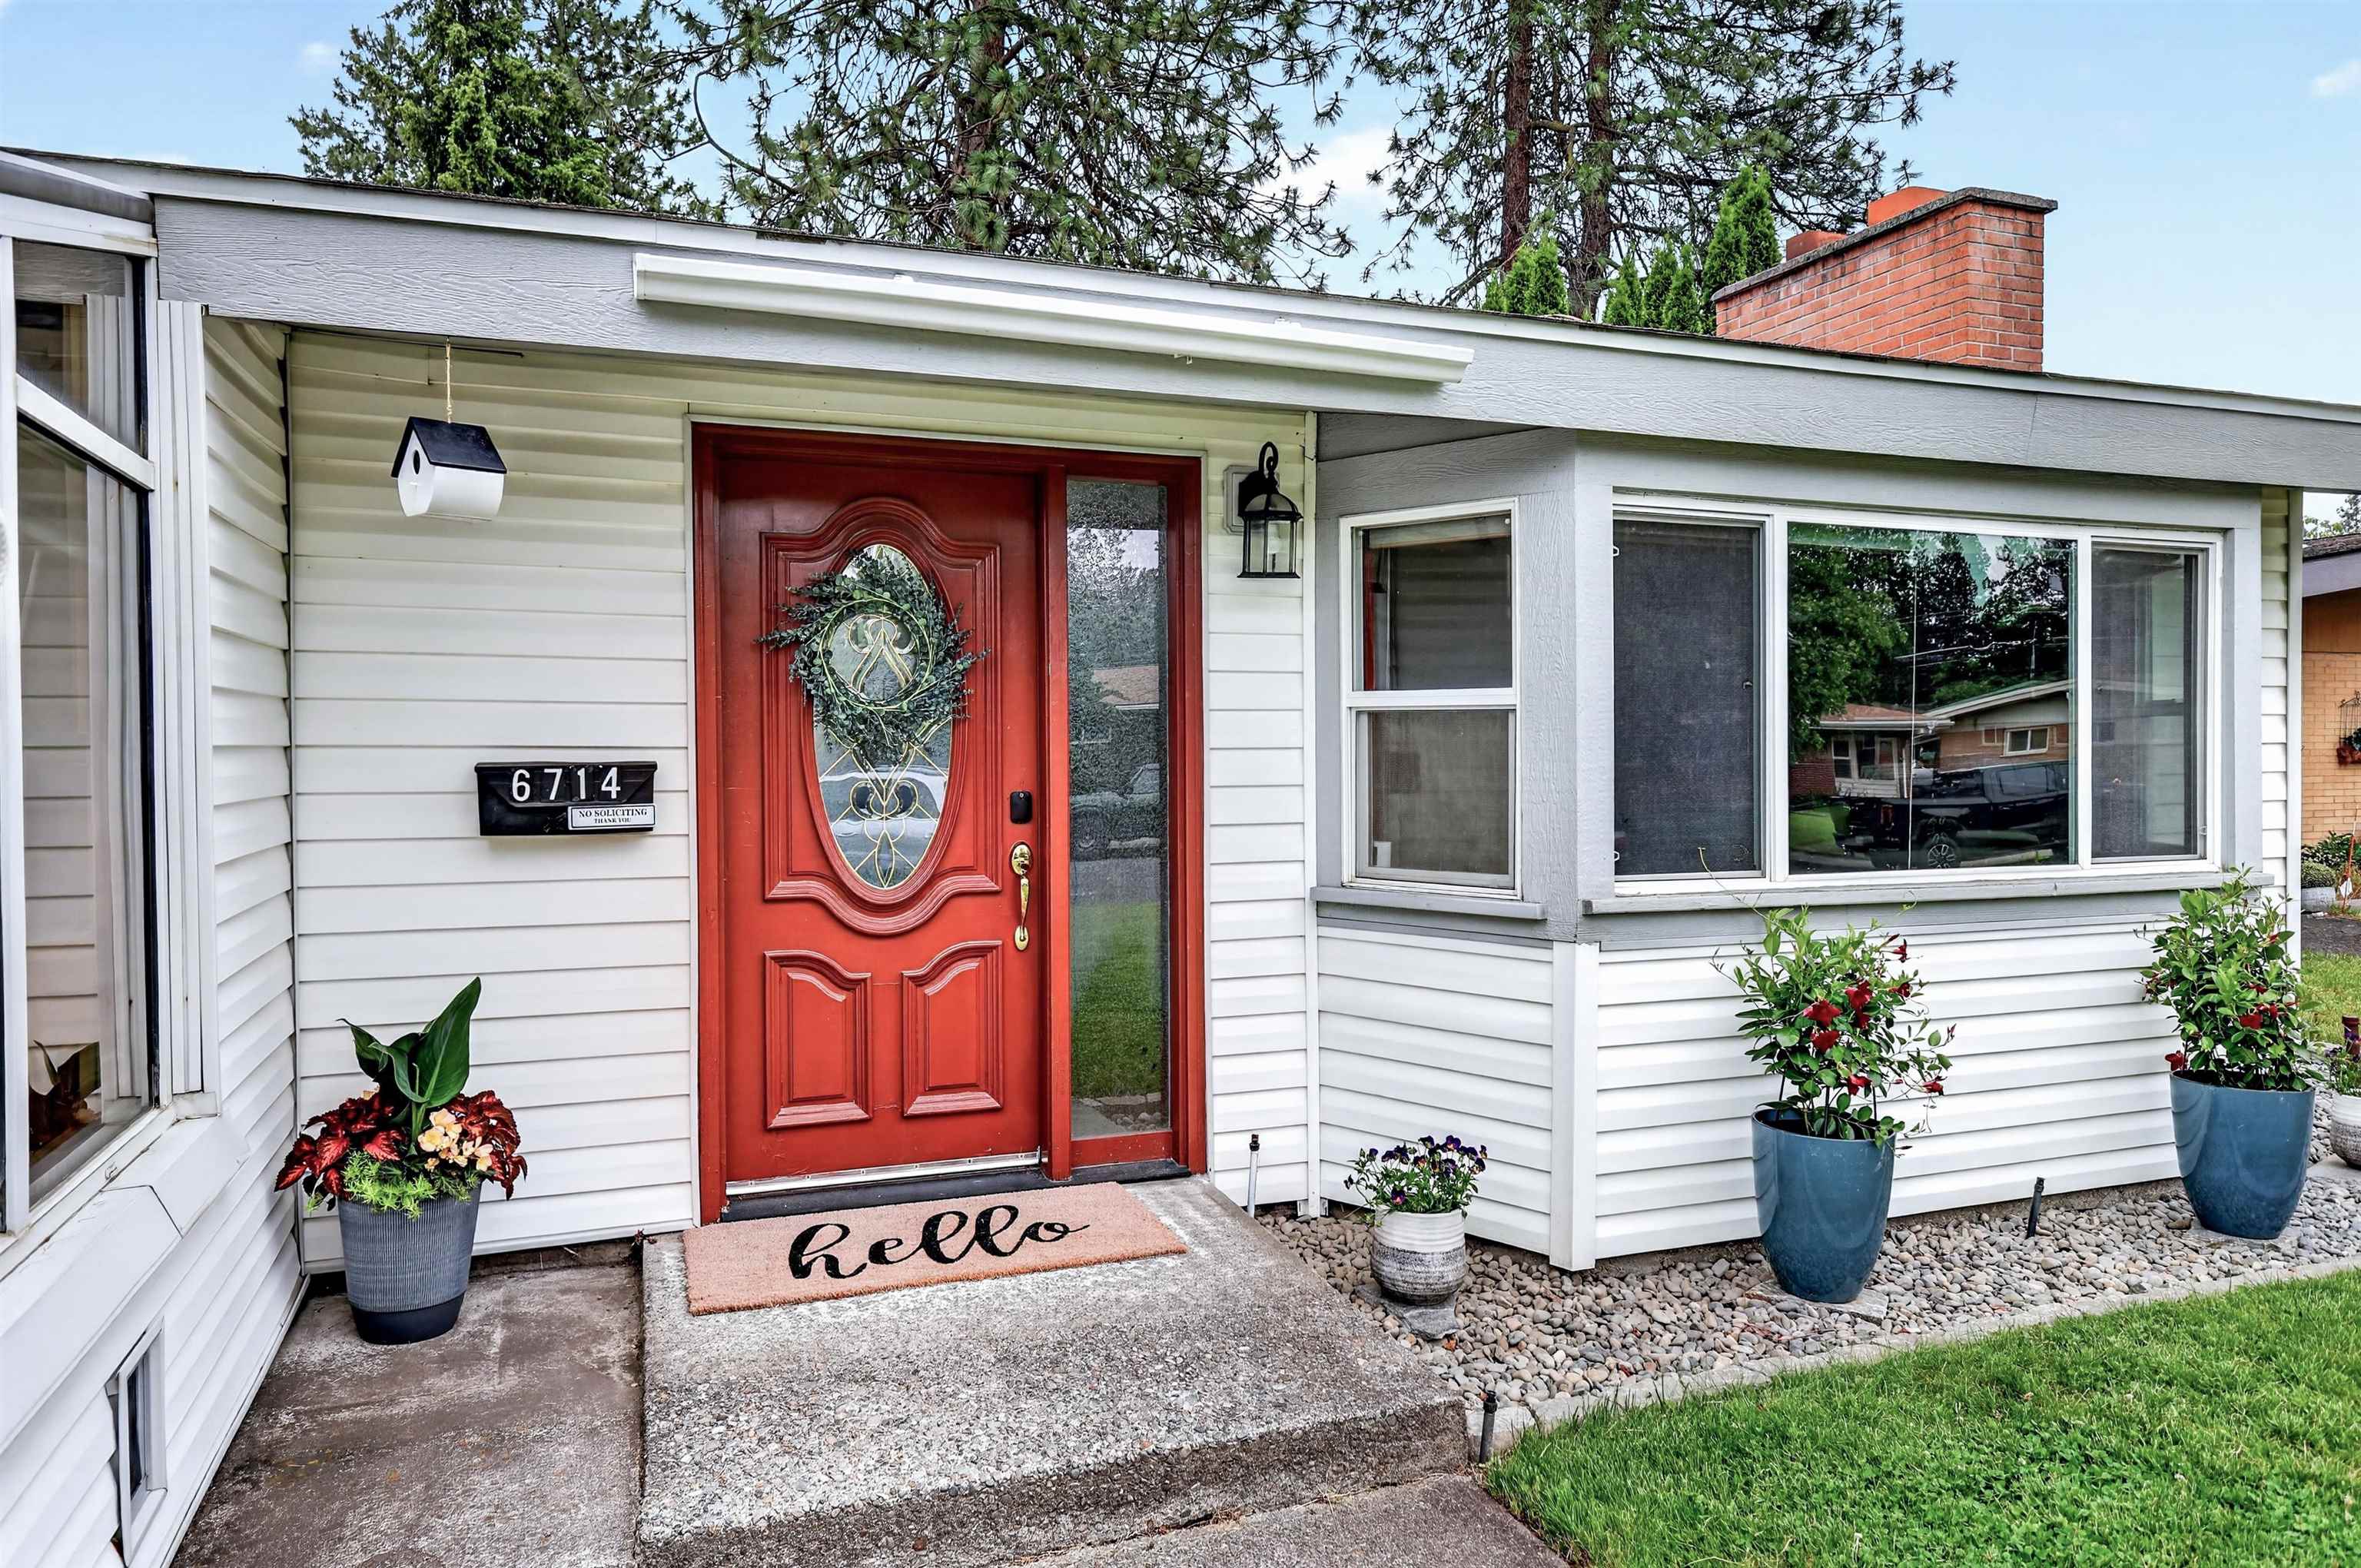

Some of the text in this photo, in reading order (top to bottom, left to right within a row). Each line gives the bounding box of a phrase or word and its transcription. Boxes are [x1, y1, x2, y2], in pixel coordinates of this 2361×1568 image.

[511, 767, 621, 802] 6714
[594, 808, 647, 817] SOLICITING
[788, 1204, 1091, 1279] hello
